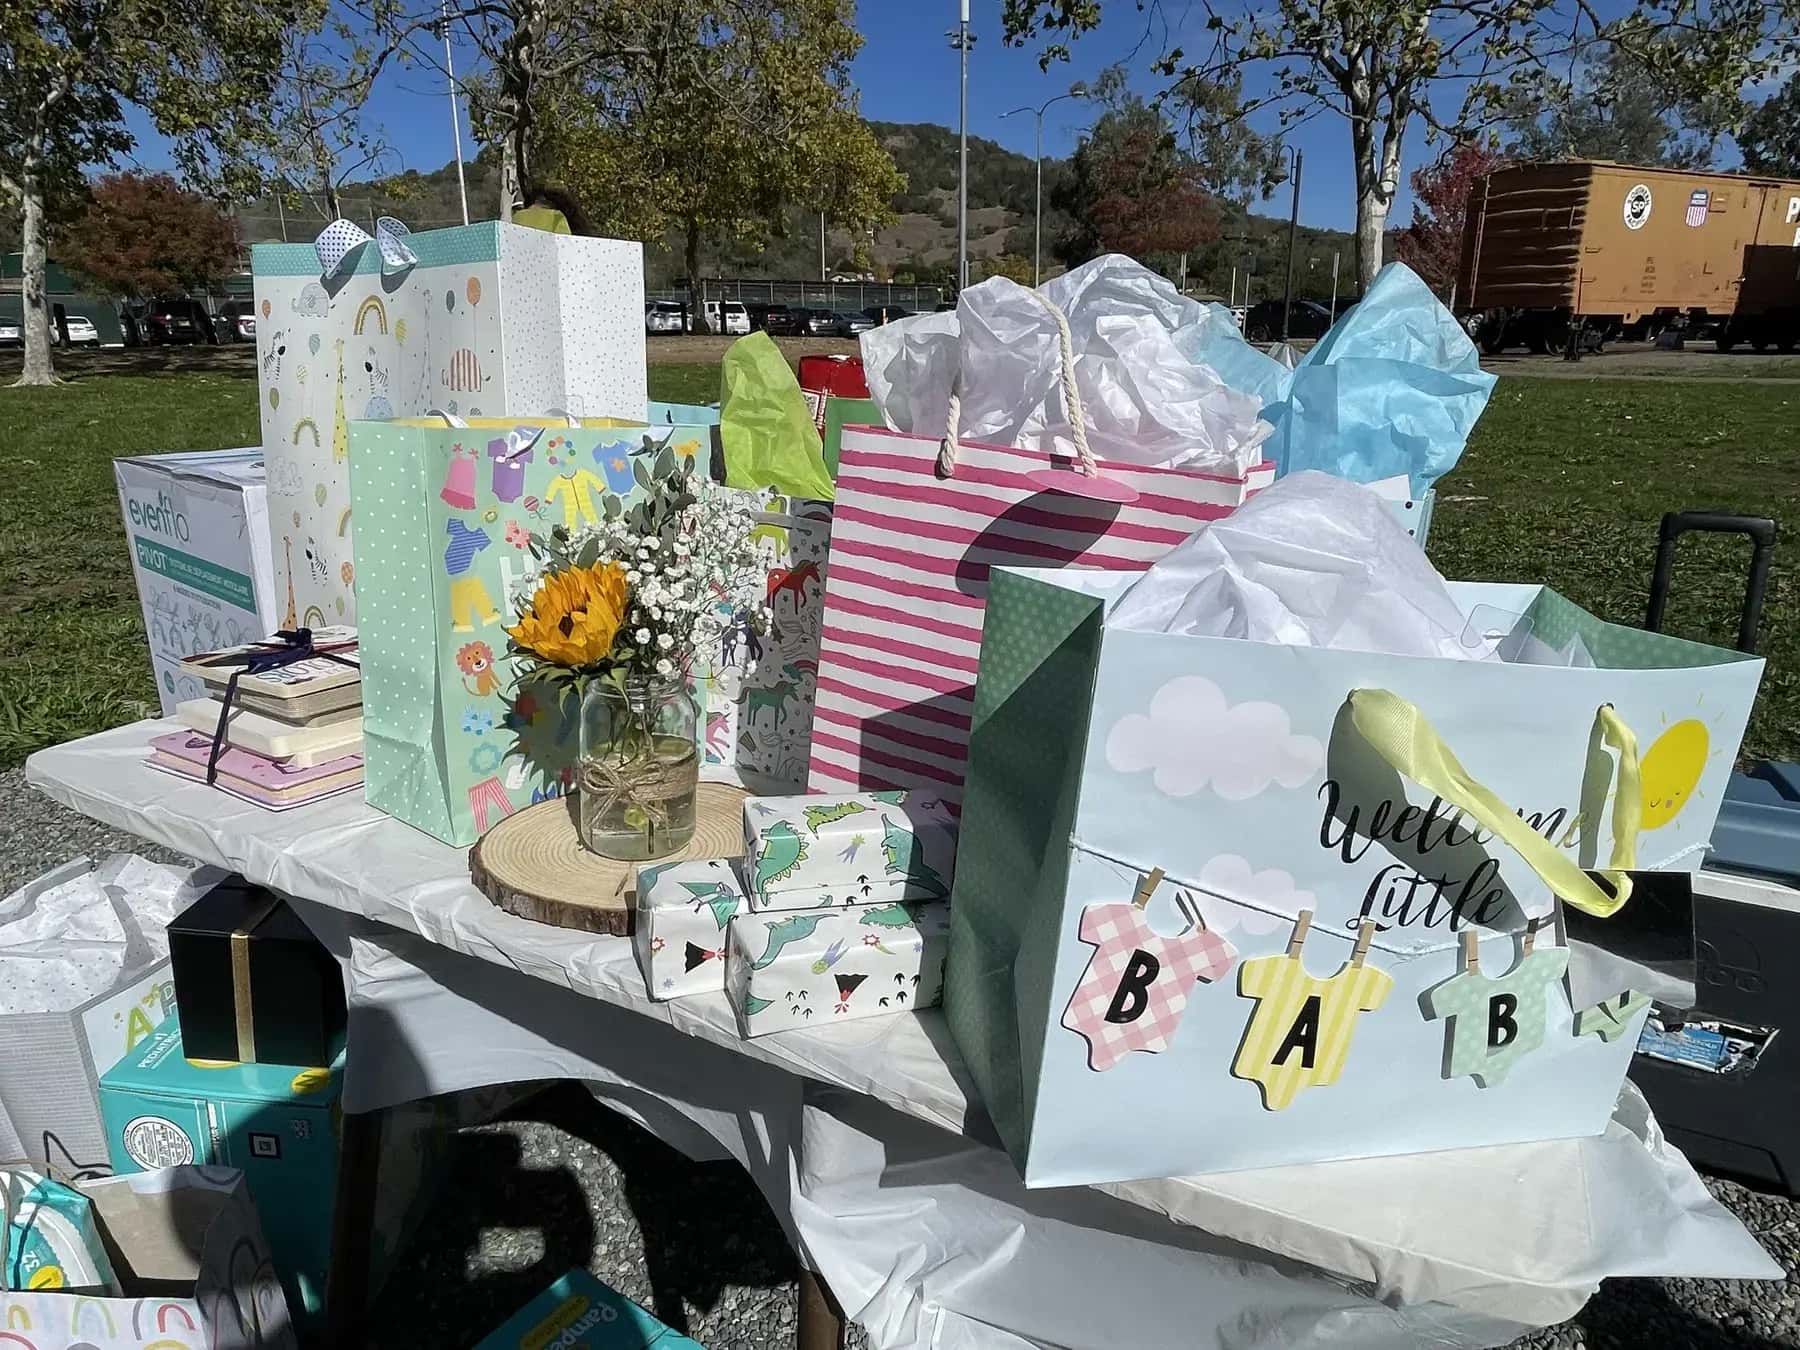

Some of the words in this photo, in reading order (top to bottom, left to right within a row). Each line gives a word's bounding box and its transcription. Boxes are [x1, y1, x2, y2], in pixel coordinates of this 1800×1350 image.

[1631, 200, 1646, 214] SP
[128, 488, 190, 542] evenflo
[137, 543, 168, 572] PIVOT
[1345, 858, 1506, 932] Little
